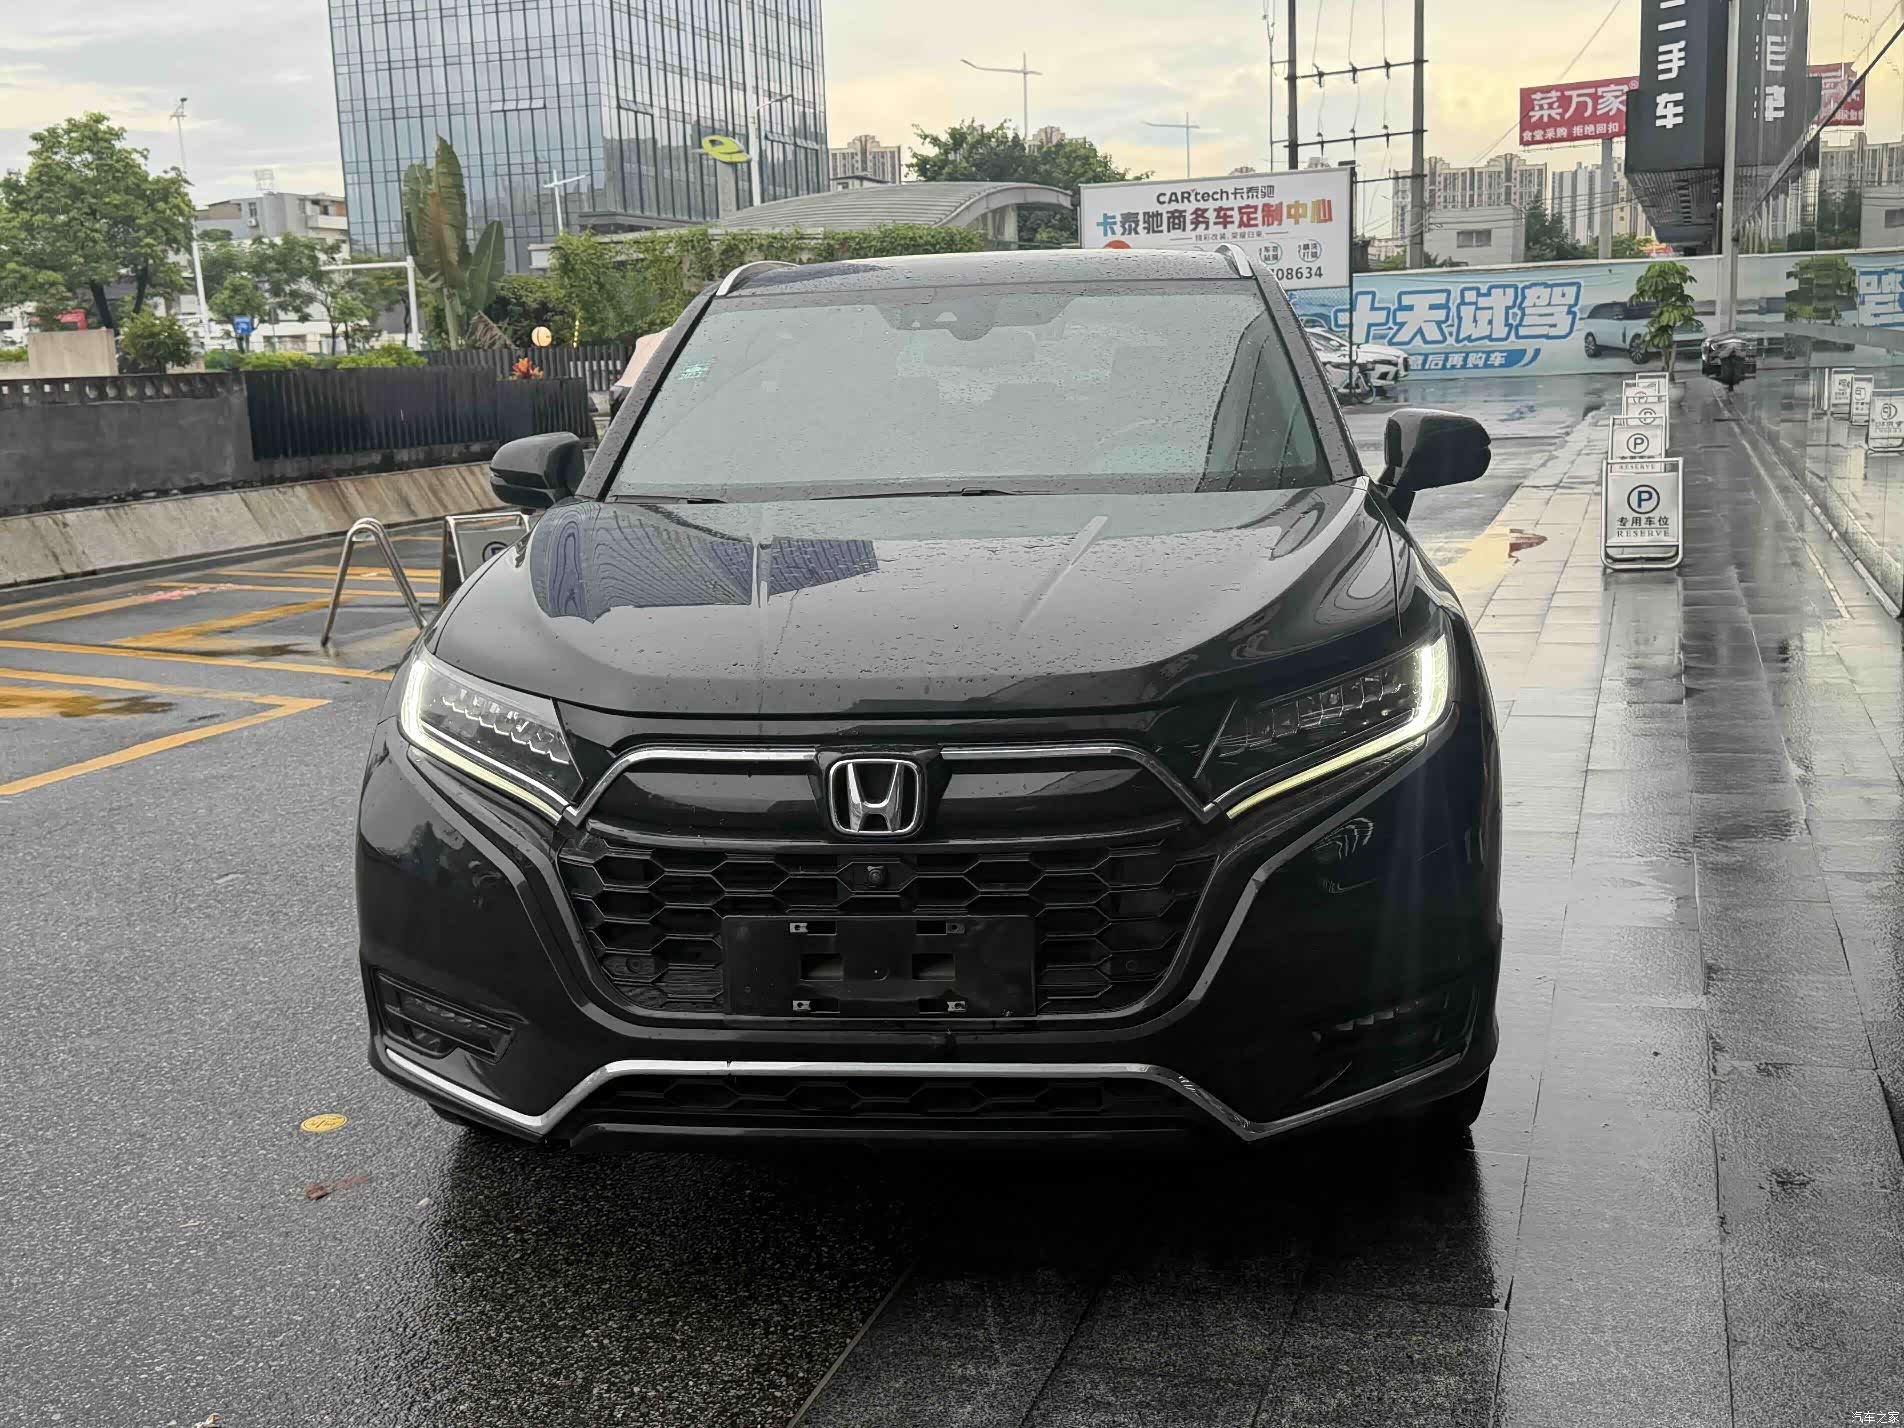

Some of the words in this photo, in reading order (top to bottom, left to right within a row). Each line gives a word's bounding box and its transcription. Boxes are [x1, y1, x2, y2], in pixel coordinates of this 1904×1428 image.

[1655, 0, 1686, 129] 二手车
[1528, 84, 1629, 122] 菜万家
[1096, 199, 1333, 237] 卡泰驰商务车定制中心
[1271, 266, 1323, 281] 08634
[1333, 282, 1582, 346] 十天试驾
[1617, 516, 1669, 526] 专用车位
